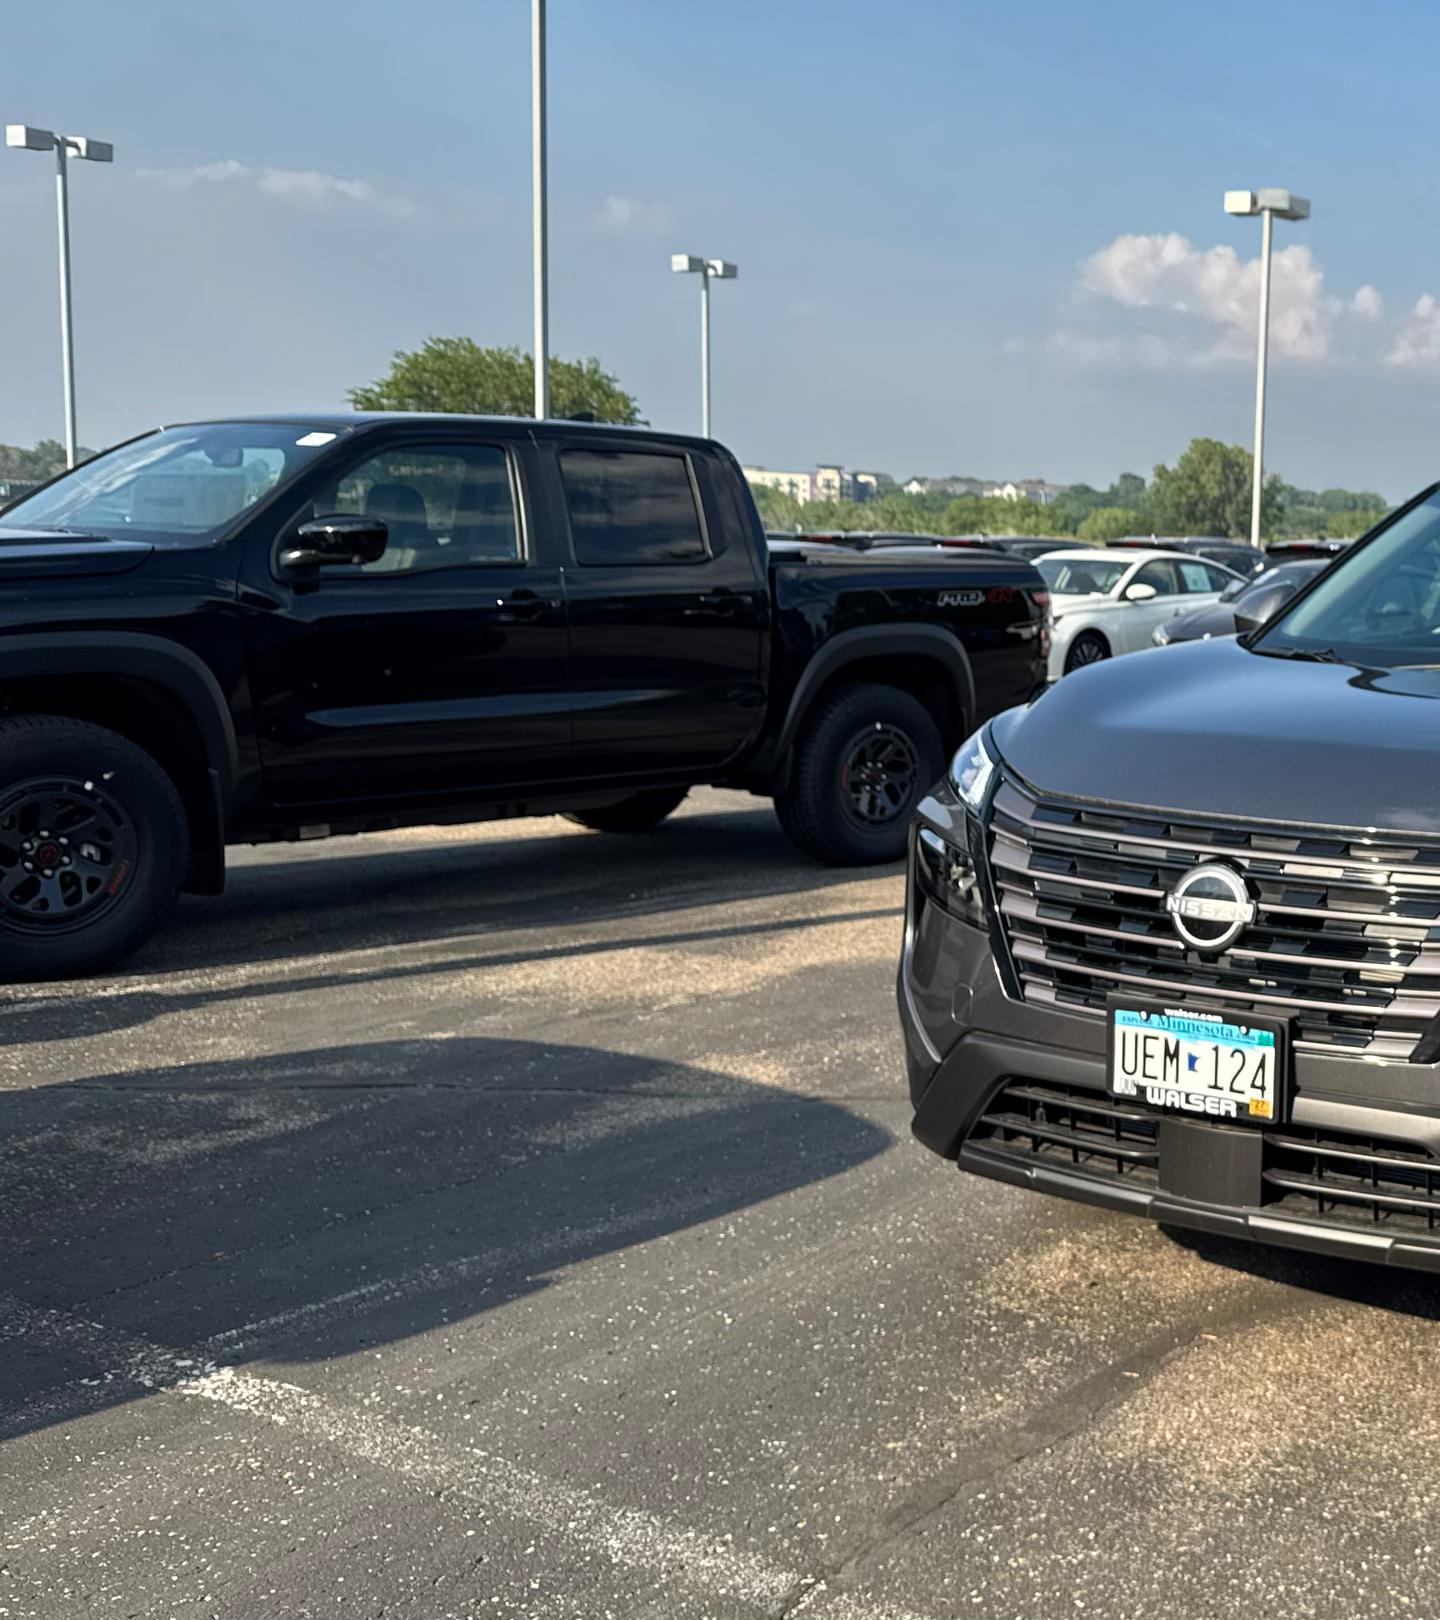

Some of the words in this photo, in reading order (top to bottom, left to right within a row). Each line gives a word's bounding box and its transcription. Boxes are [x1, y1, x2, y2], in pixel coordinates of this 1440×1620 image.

[1166, 896, 1252, 921] NISSAN
[1163, 1008, 1223, 1024] walser.com
[1121, 1031, 1180, 1084] UEM
[1207, 1044, 1267, 1099] 124
[1146, 1086, 1237, 1118] WALSER
